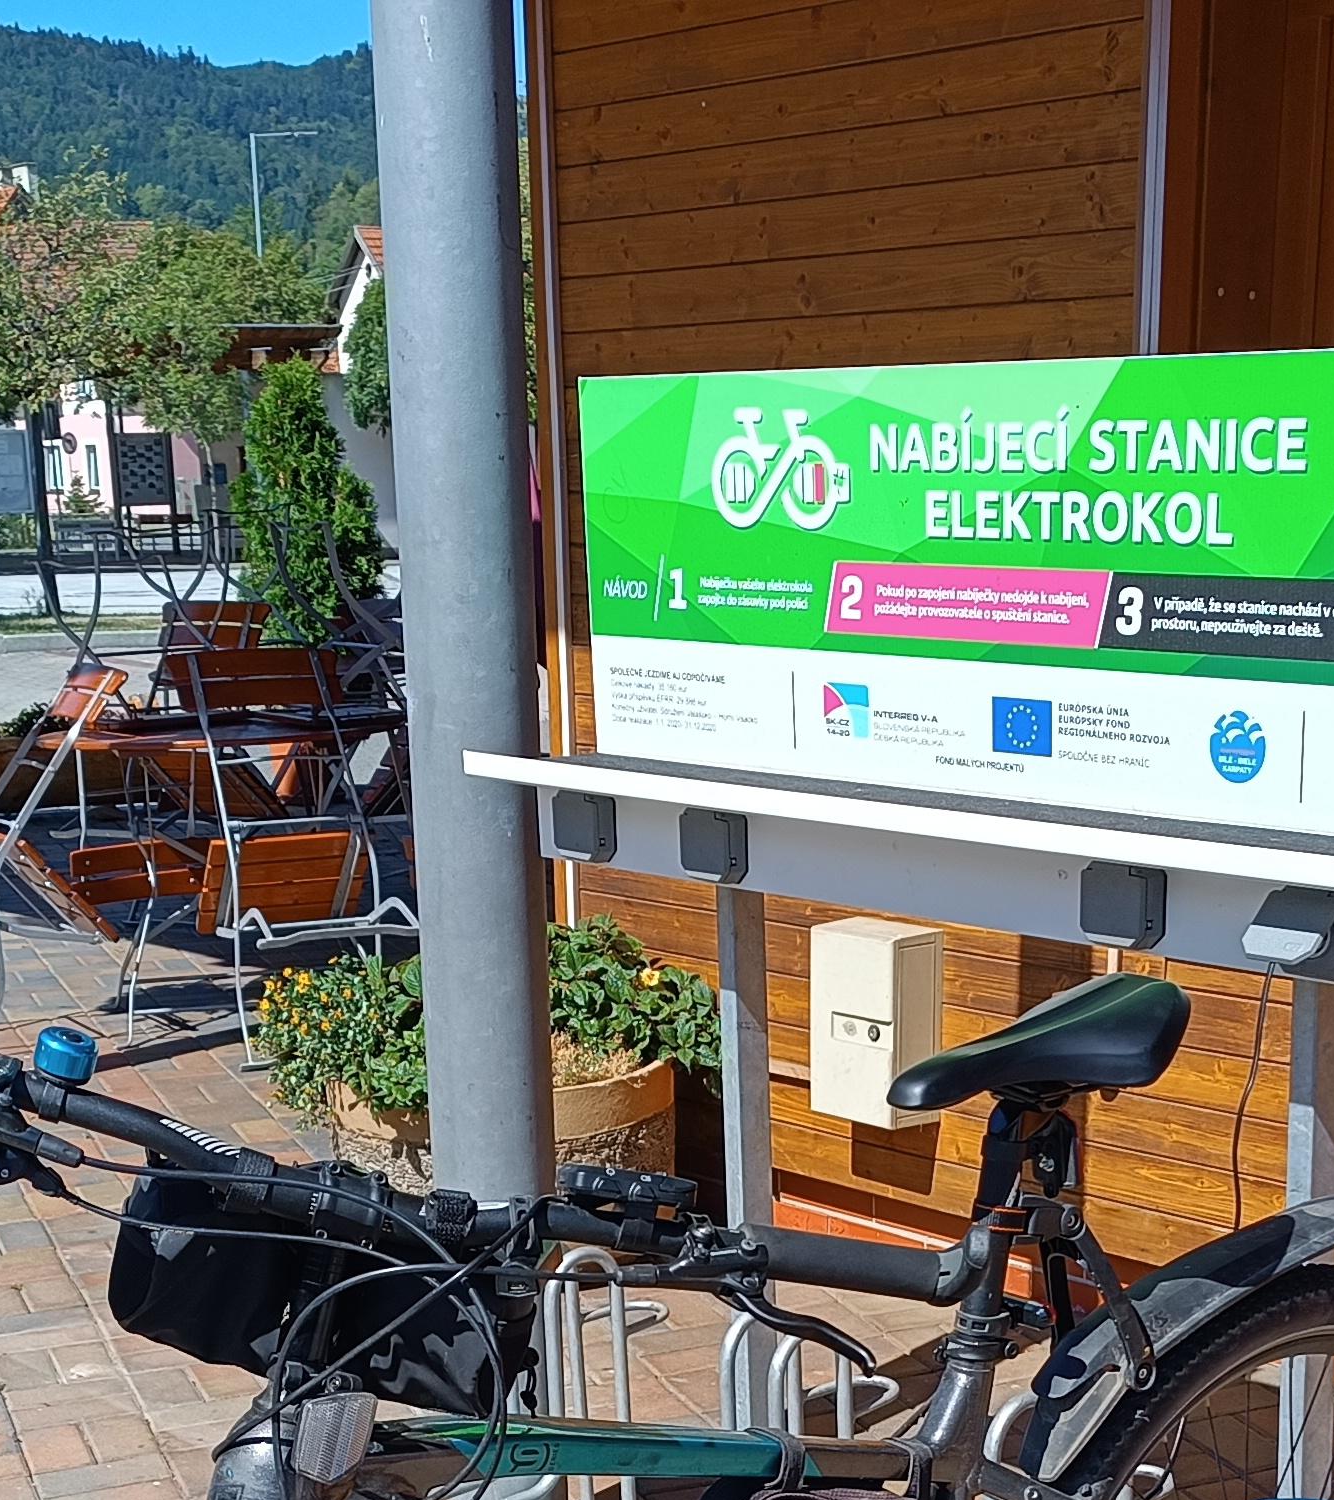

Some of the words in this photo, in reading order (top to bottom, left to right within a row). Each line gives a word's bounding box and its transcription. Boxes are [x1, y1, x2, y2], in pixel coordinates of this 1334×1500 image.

[869, 405, 1069, 473] NABÍJECÍ
[1088, 417, 1309, 473] STANICE
[925, 490, 1234, 546] ELEKTROKOL
[603, 575, 648, 599] NÁVOD
[669, 567, 687, 610] 1
[876, 584, 904, 598] Pokud
[905, 588, 917, 600] po
[917, 586, 955, 603] zapojení
[956, 587, 1000, 605] nabíječky
[1001, 588, 1039, 606] nedojde
[1040, 589, 1047, 604] k
[1048, 590, 1090, 608] nabíjení,
[840, 575, 863, 620] 2
[1153, 597, 1163, 610] V
[1164, 597, 1207, 613] případě,
[1209, 598, 1222, 612] že
[1223, 601, 1236, 613] se
[1237, 600, 1277, 616] stanice
[1279, 601, 1322, 618] nachází
[1323, 606, 1331, 618] v
[874, 602, 917, 617] požádejte
[918, 604, 983, 619] provozovatele
[984, 610, 991, 619] o
[992, 607, 1032, 623] spuštění
[1033, 610, 1071, 625] stanice.
[1116, 586, 1144, 636] 3
[1151, 617, 1200, 633] prostoru,
[1201, 618, 1272, 637] nepoužívejte
[1272, 623, 1286, 636] za
[921, 714, 938, 723] V-A
[1058, 701, 1104, 715] EURÓPSKA
[1106, 704, 1129, 717] ÚNIA
[825, 718, 850, 727] SK-CZ
[826, 727, 851, 737] 14-20
[1106, 718, 1130, 729] FOND
[1129, 733, 1171, 746] ROZVOJA
[935, 755, 954, 766] FOND
[1101, 754, 1116, 765] BEZ
